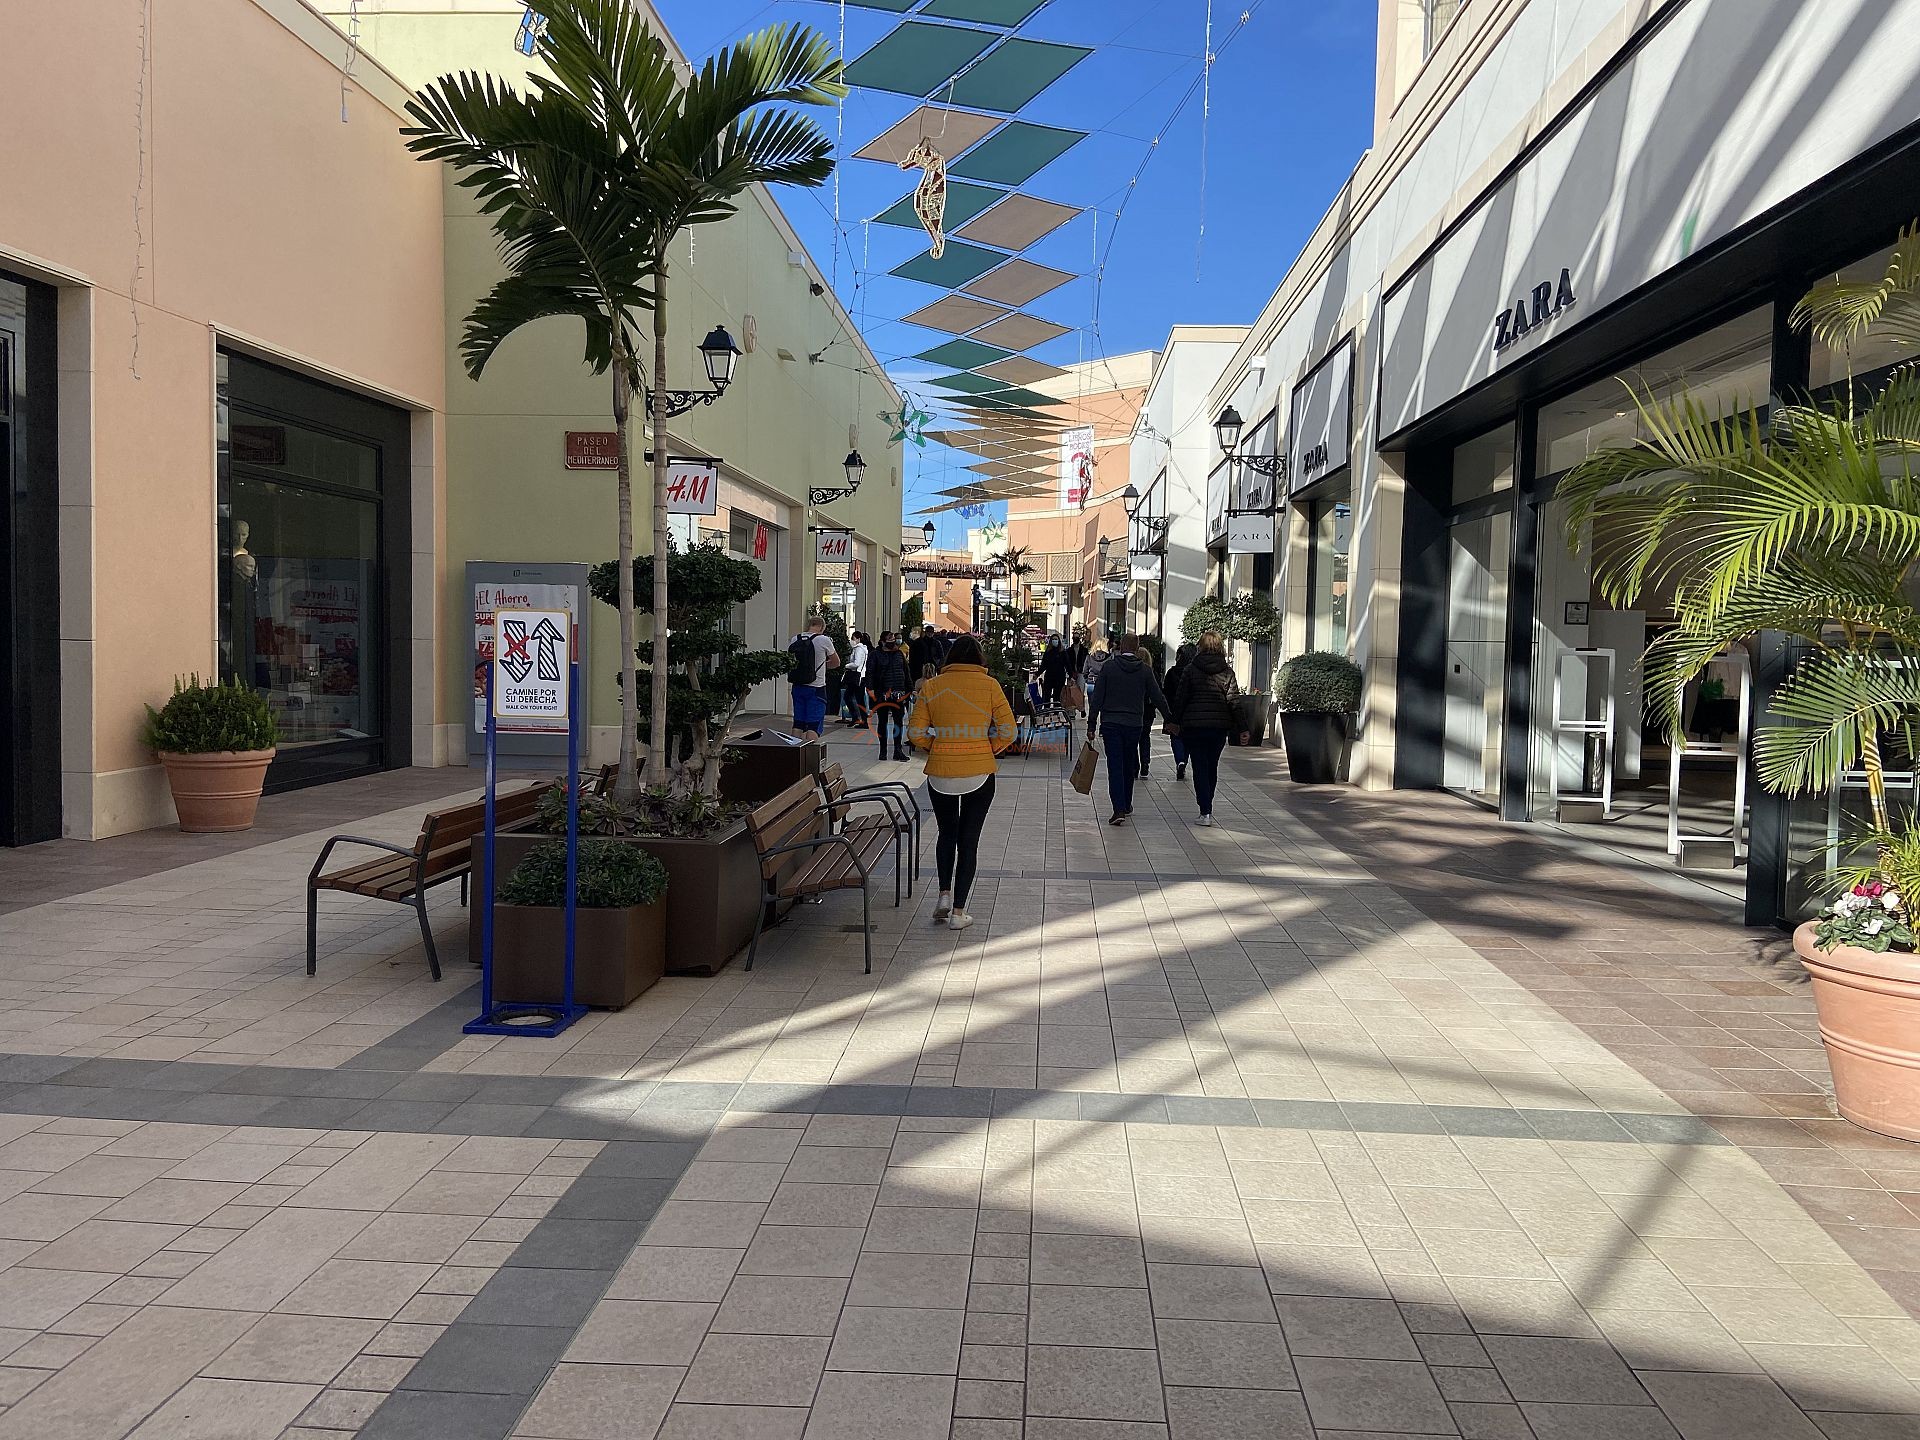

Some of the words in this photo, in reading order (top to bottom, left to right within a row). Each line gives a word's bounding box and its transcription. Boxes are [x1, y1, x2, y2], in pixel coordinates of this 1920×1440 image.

[1493, 268, 1577, 351] ZARA
[577, 436, 608, 446] PASEO
[583, 446, 601, 456] DEL
[567, 455, 618, 465] MEDITERRANEO
[1303, 441, 1328, 477] ZARA
[666, 474, 710, 505] H&M
[1230, 533, 1271, 541] ZARA
[821, 538, 848, 556] H&M
[494, 589, 528, 605] Ahorro
[475, 612, 495, 620] SUPE
[505, 688, 538, 696] CAMINE
[540, 688, 557, 696] POR
[505, 695, 516, 703] SU
[518, 696, 558, 704] DERECHA
